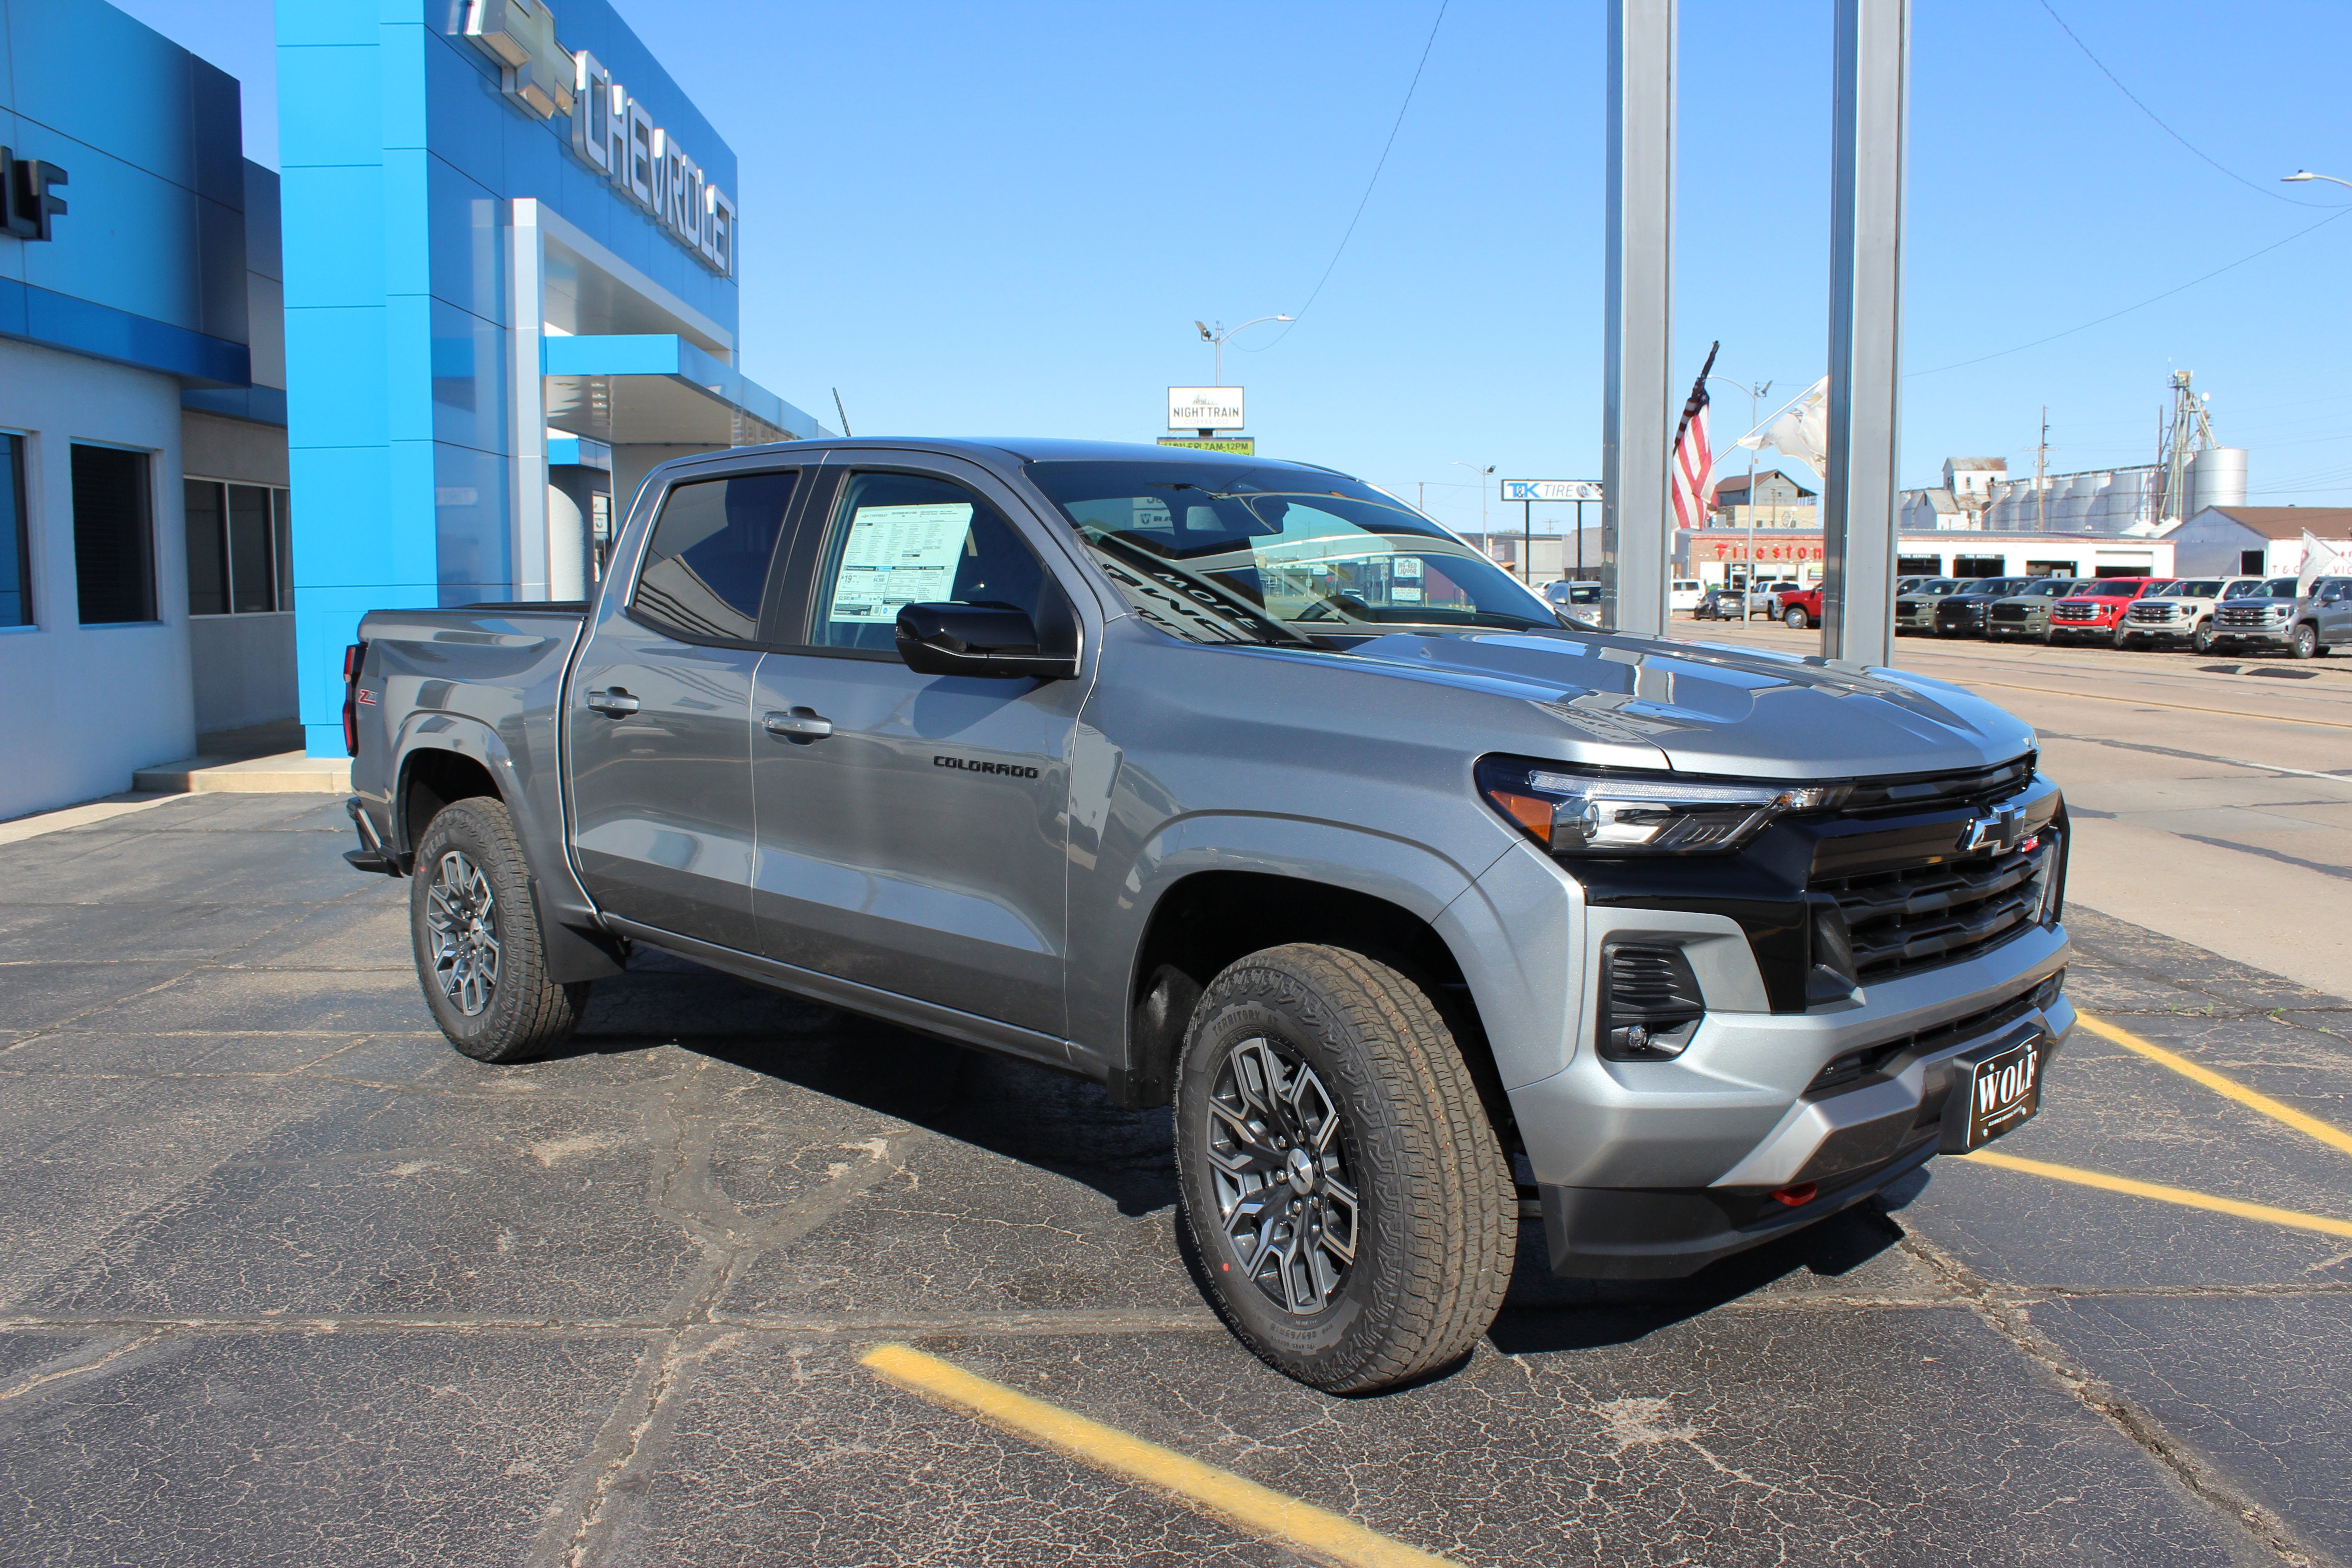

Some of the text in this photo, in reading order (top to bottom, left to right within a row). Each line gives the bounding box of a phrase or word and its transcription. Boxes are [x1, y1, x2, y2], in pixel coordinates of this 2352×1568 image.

[572, 50, 736, 278] CHEVROLET
[1173, 407, 1239, 417] NIGHT TRAIN
[1506, 482, 1541, 498] T&K
[1543, 484, 1575, 497] TIRE
[844, 574, 853, 583] 19
[933, 755, 1038, 779] COLORADO
[1212, 1009, 1260, 1037] TERRITORY
[1978, 1050, 2038, 1114] WOLF
